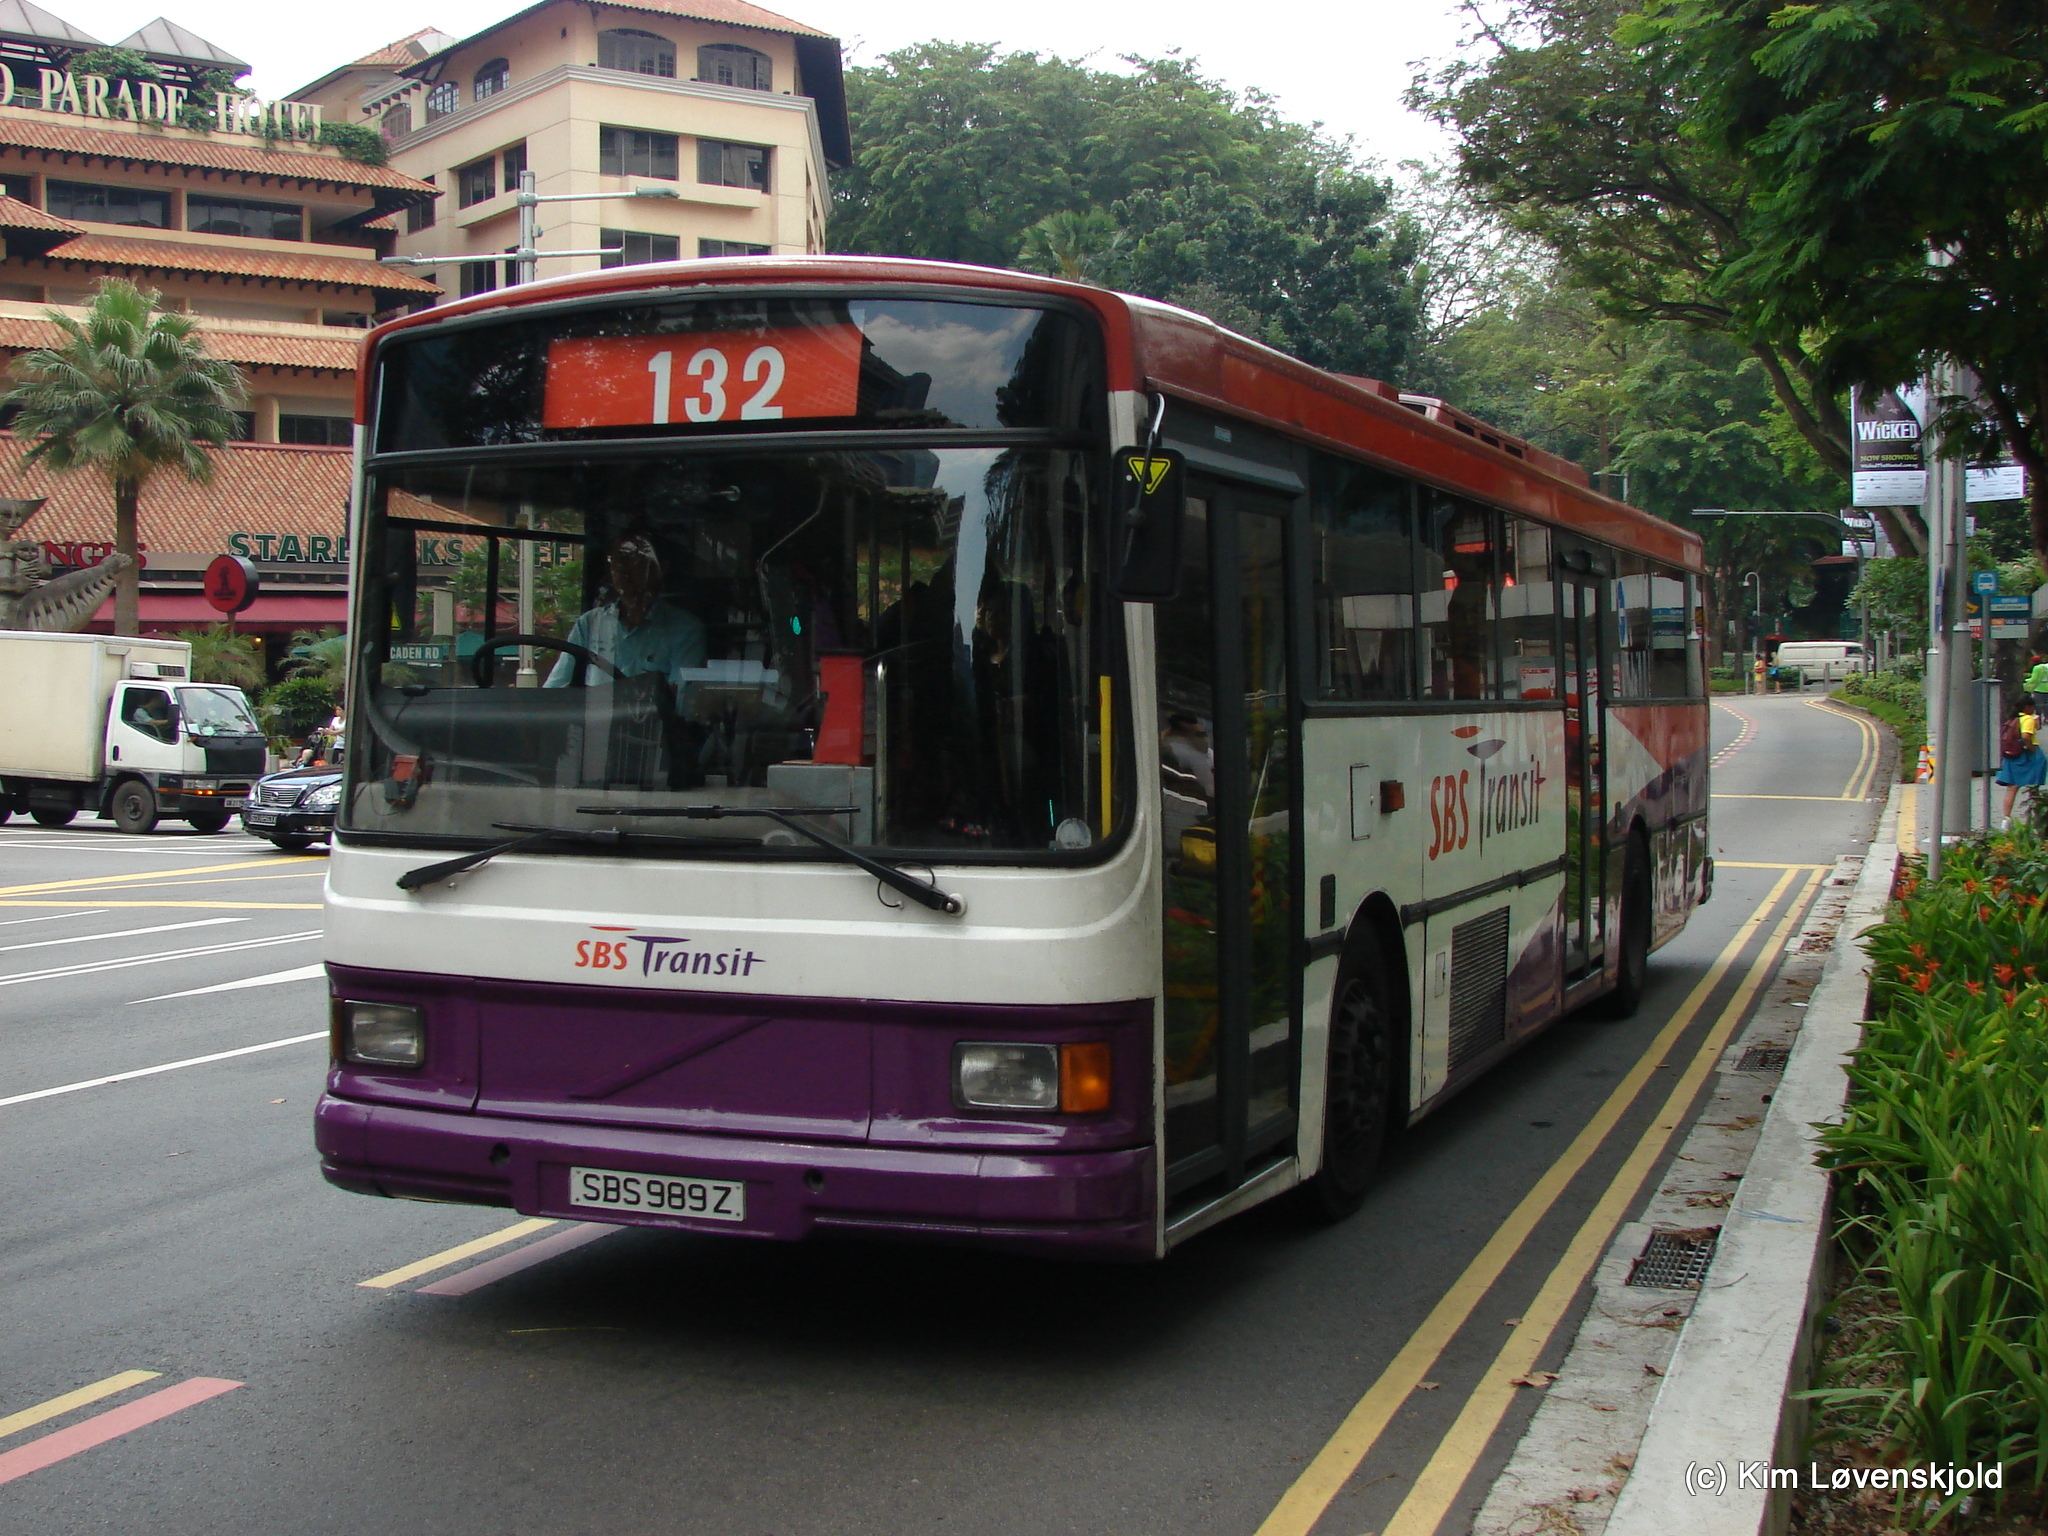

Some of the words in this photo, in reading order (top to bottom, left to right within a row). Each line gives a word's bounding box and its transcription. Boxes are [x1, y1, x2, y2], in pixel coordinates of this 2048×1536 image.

[38, 68, 188, 126] PARADE
[215, 91, 325, 141] HOTEL
[648, 345, 786, 424] 132
[1860, 454, 1880, 462] NOW
[1881, 453, 1919, 462] SHOWING
[424, 646, 440, 660] RD
[1428, 768, 1469, 861] SBS
[1466, 739, 1547, 860] Transit
[574, 939, 628, 971] SBS
[625, 935, 767, 978] Transit
[582, 1173, 733, 1215] SBS989Z
